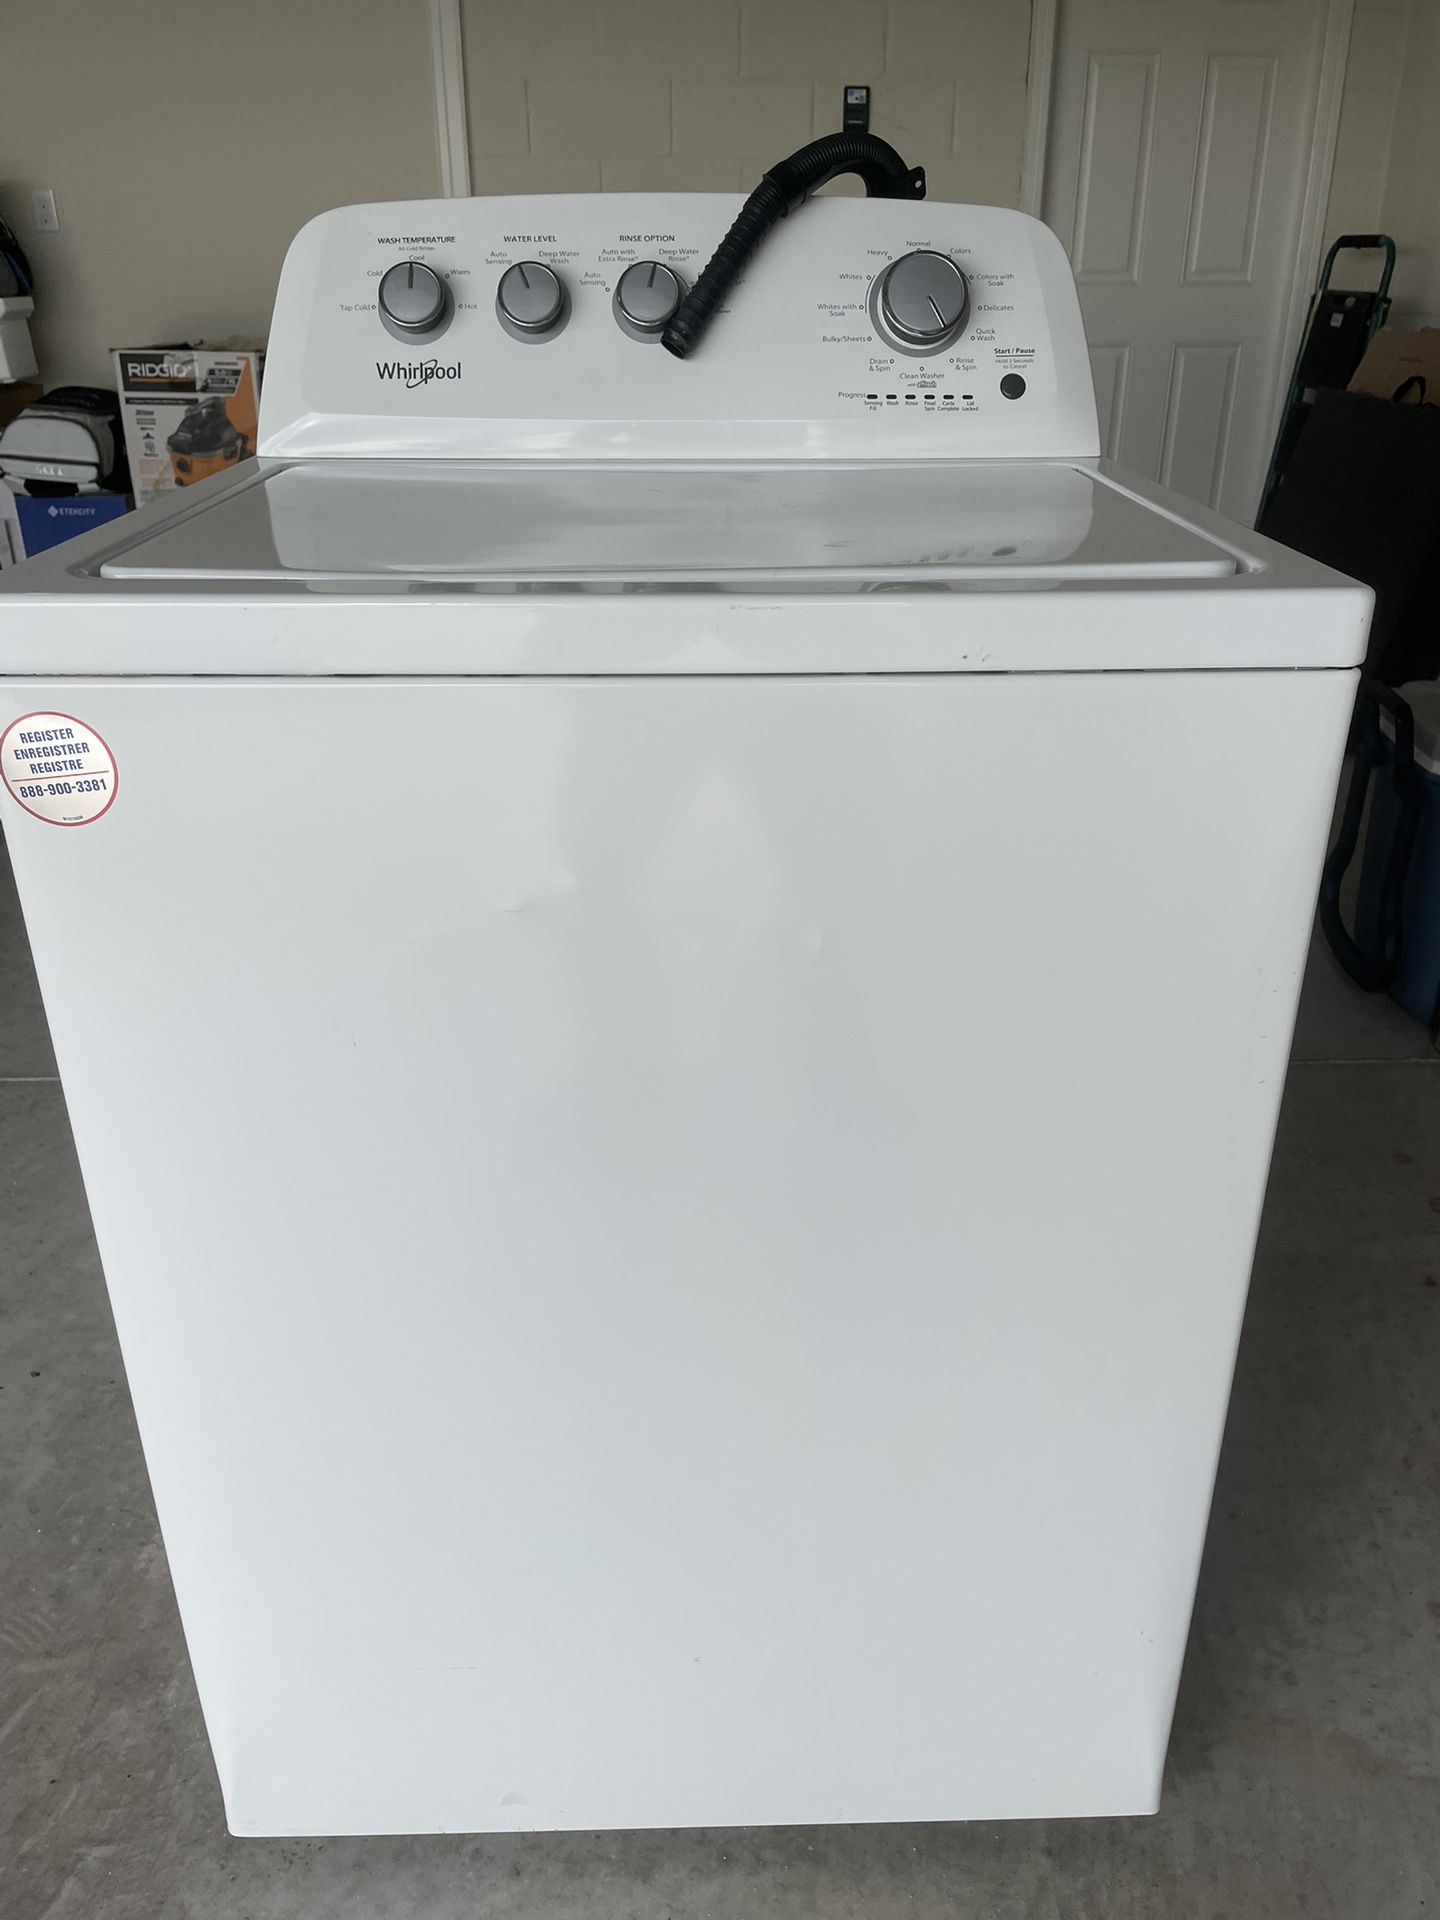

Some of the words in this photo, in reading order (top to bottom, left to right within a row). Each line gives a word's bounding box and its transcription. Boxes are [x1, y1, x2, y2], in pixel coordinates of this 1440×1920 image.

[127, 363, 188, 378] RIDGID
[376, 360, 461, 387] Whirlpool
[20, 728, 74, 743] REGISTER
[14, 742, 90, 760] ENREGISTRER
[30, 759, 84, 774] REGISTRE
[20, 779, 107, 798] 888-900-3381
